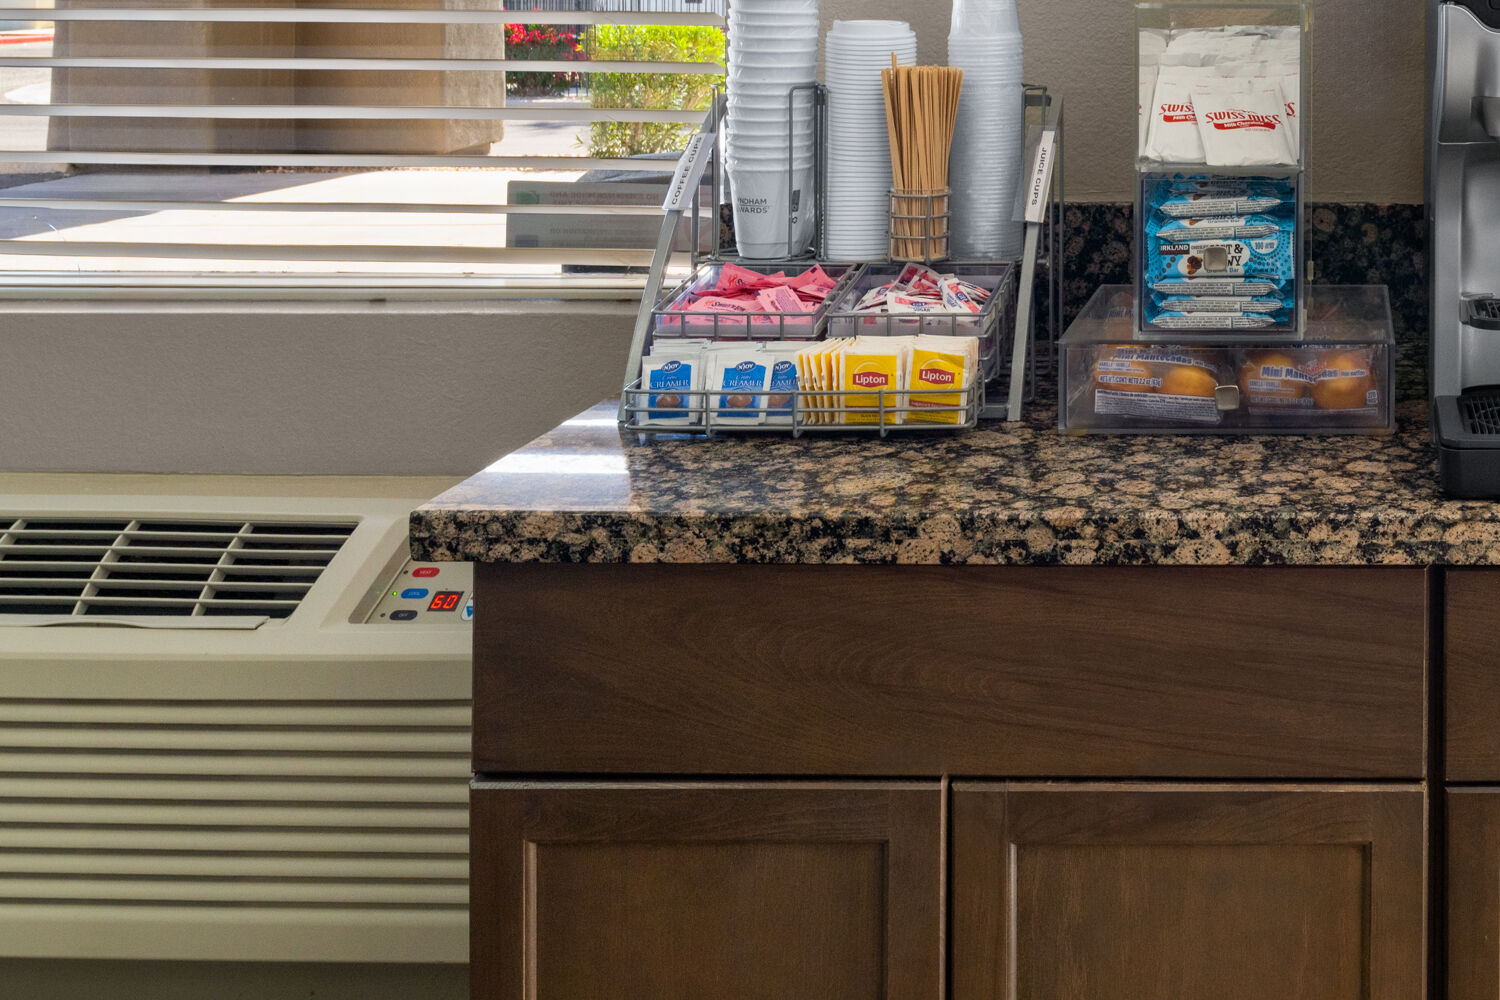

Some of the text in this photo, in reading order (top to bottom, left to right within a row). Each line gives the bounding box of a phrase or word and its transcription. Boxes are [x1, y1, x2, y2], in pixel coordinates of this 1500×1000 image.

[1205, 111, 1246, 124] SWISS
[671, 136, 702, 205] COFFEE CUPS
[1031, 147, 1047, 206] JUICE CUPS
[1234, 244, 1244, 254] &
[922, 370, 952, 382] Lipton
[1262, 367, 1283, 377] Mini
[855, 375, 885, 385] Lipton
[430, 594, 459, 609] 60
